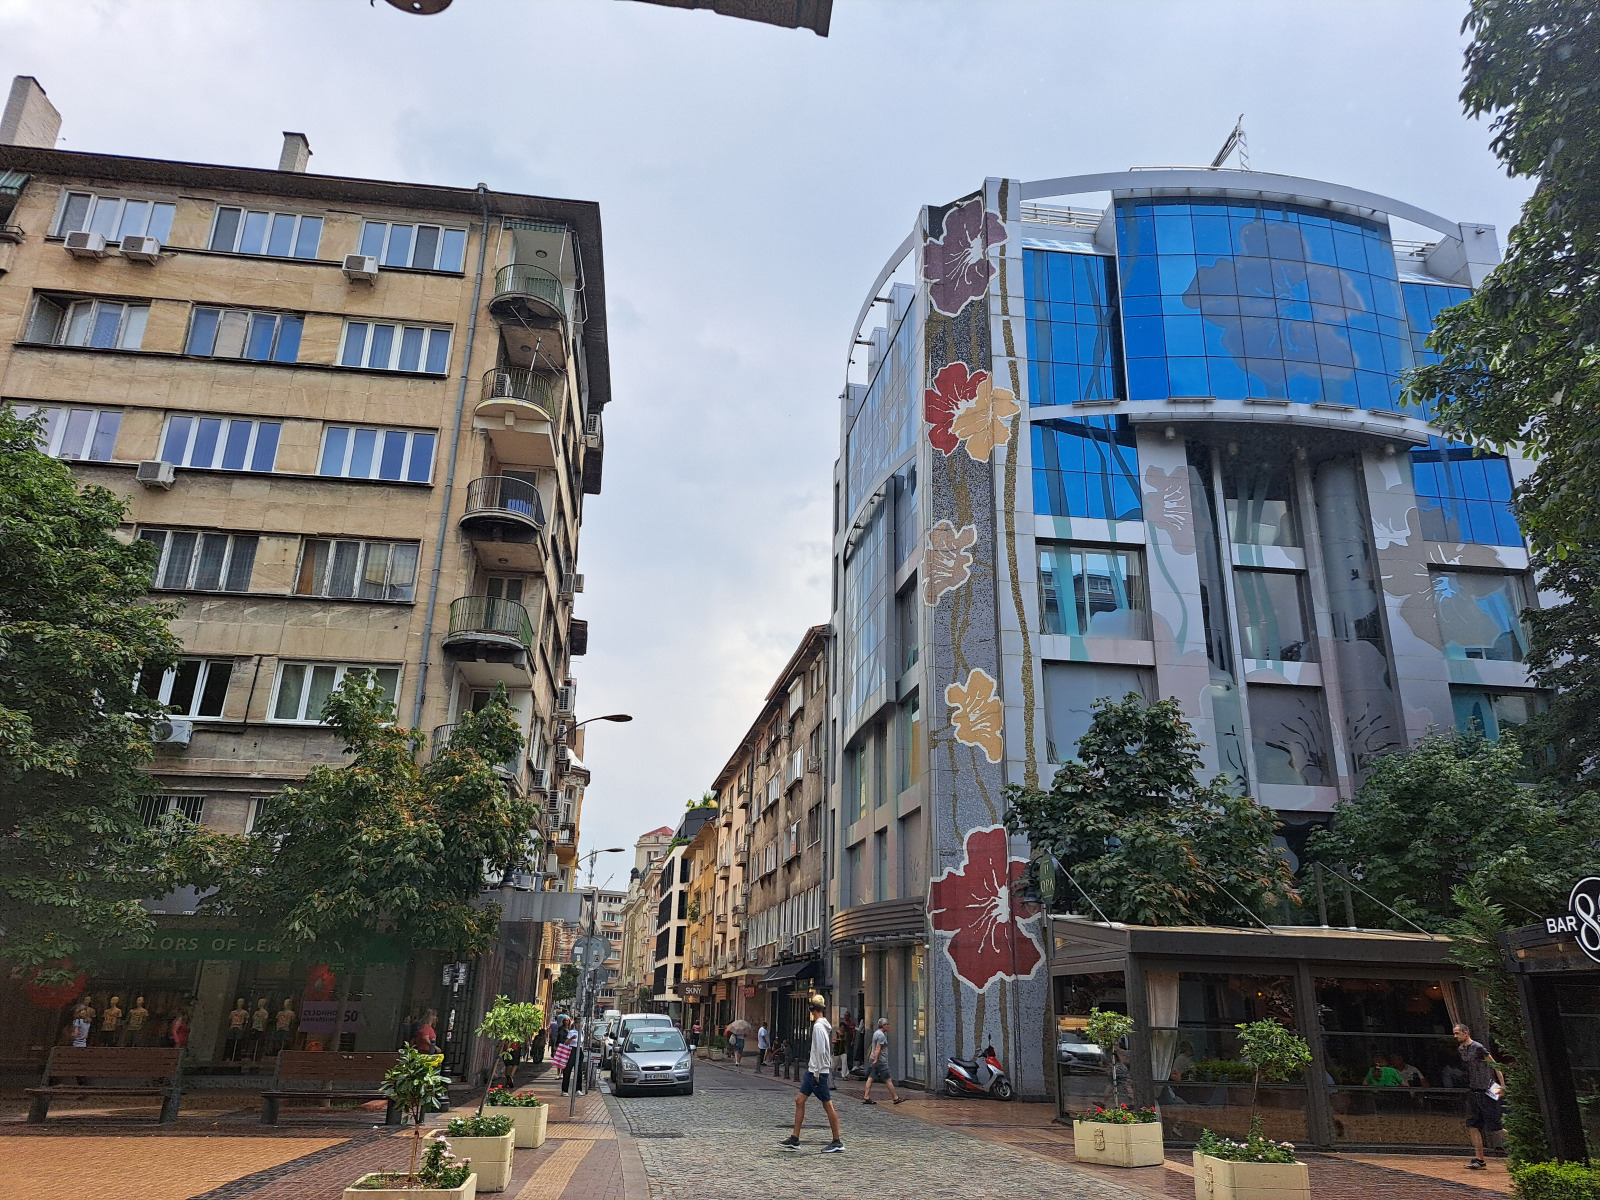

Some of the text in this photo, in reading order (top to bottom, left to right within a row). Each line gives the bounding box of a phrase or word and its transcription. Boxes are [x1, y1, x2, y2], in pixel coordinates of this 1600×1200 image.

[1546, 916, 1578, 933] BAR
[122, 937, 199, 951] OLORS
[211, 938, 239, 952] OF
